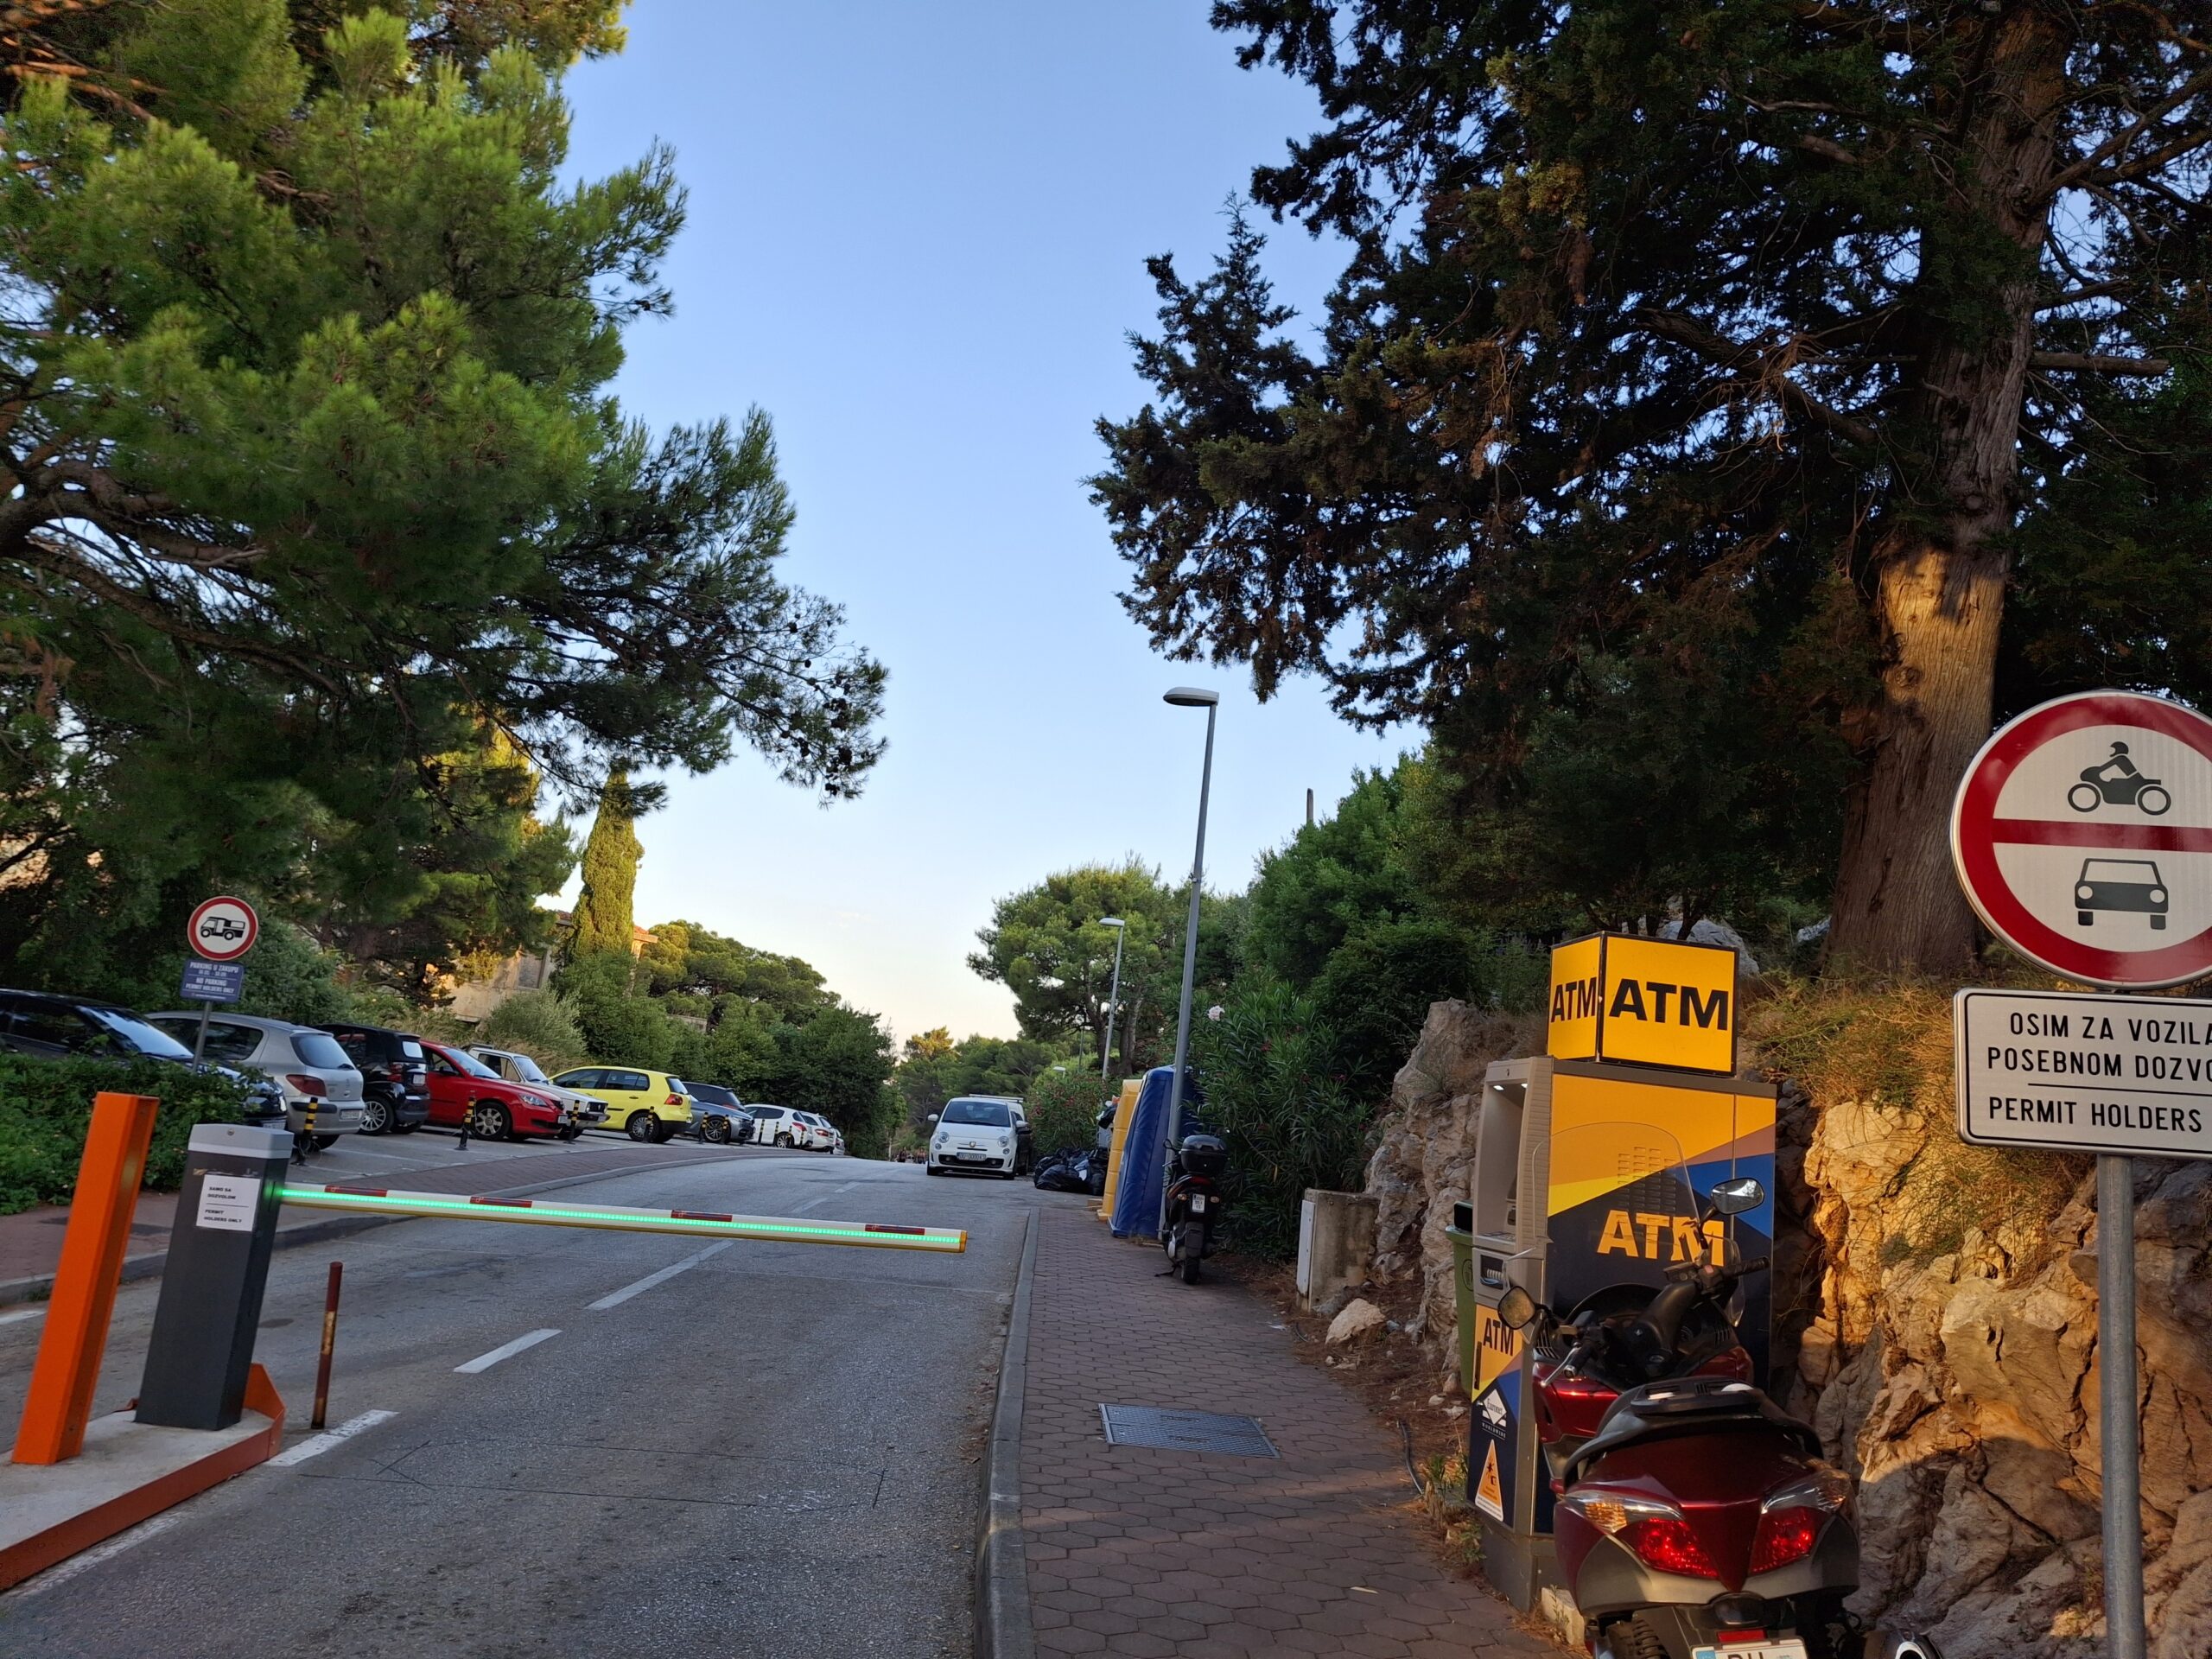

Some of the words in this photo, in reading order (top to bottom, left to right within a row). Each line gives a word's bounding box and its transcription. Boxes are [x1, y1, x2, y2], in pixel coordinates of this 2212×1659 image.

[205, 978, 227, 987] PARKING
[1551, 976, 1597, 1023] ATM
[1609, 978, 1729, 1031] ATM
[2010, 1012, 2069, 1038] OSIM
[2082, 1016, 2114, 1040] ZA
[1987, 1046, 2122, 1077] POSEBNOM
[1989, 1096, 2077, 1124] PERMIT
[2091, 1103, 2202, 1133] HOLDERS
[1597, 1210, 1725, 1267] ATM
[1483, 1318, 1515, 1357] ATM
